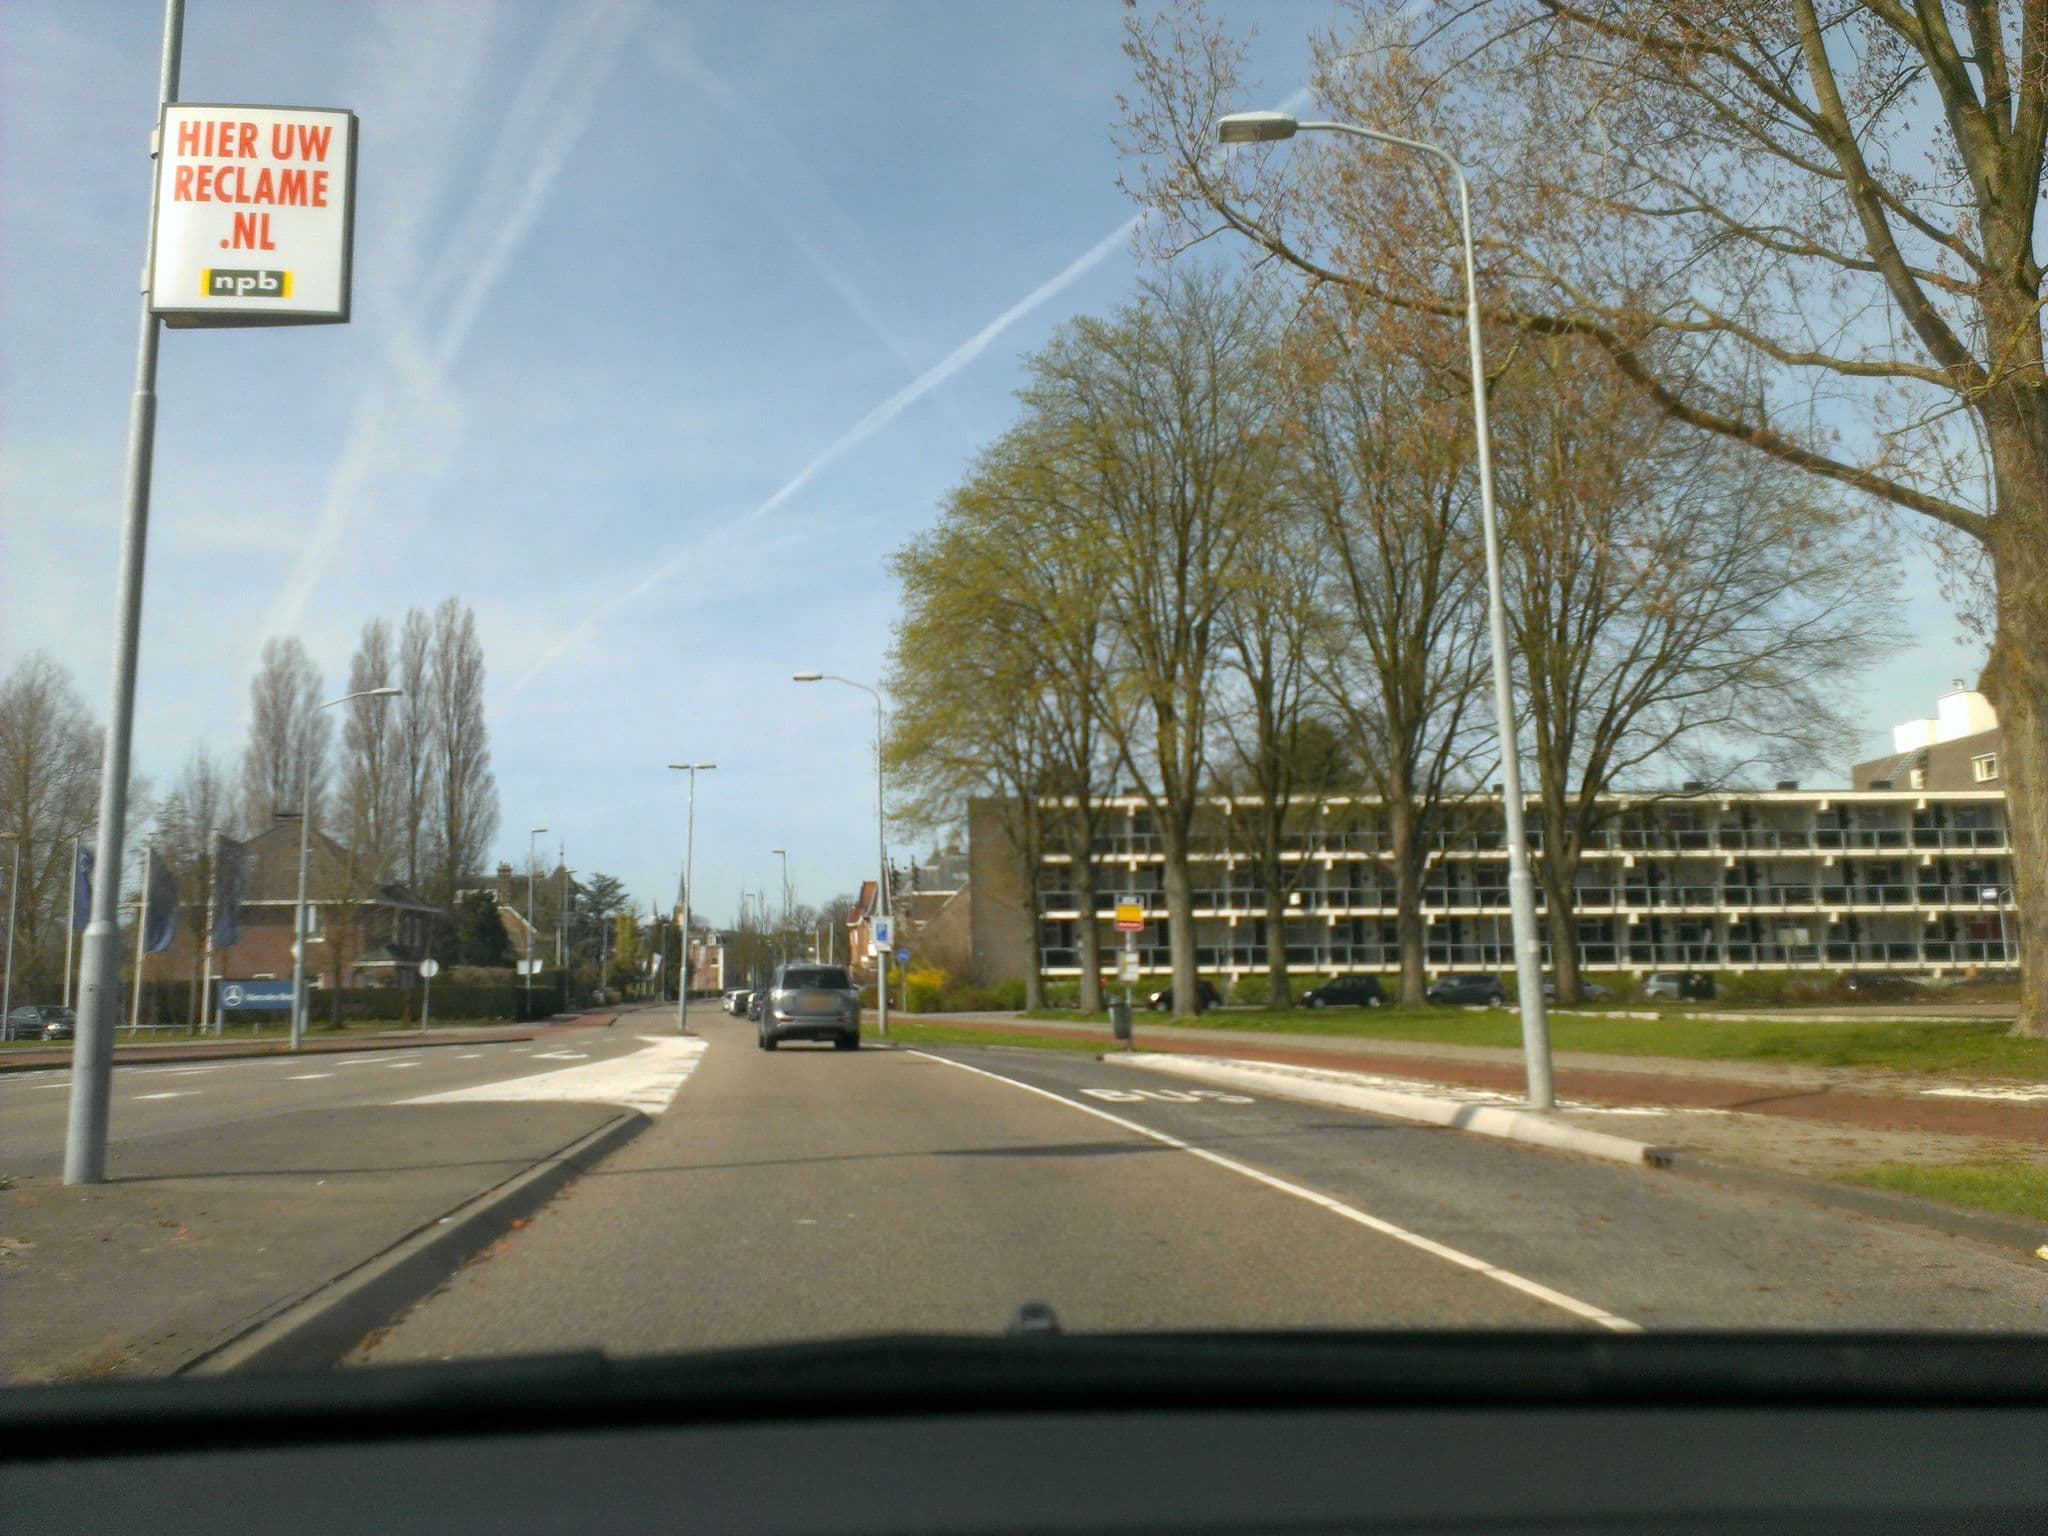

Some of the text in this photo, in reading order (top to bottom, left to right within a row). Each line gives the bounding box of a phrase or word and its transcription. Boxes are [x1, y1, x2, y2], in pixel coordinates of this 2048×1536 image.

[177, 120, 333, 162] HIER UW
[174, 165, 329, 208] RECLAME
[219, 211, 276, 251] .NL
[215, 271, 279, 297] npb
